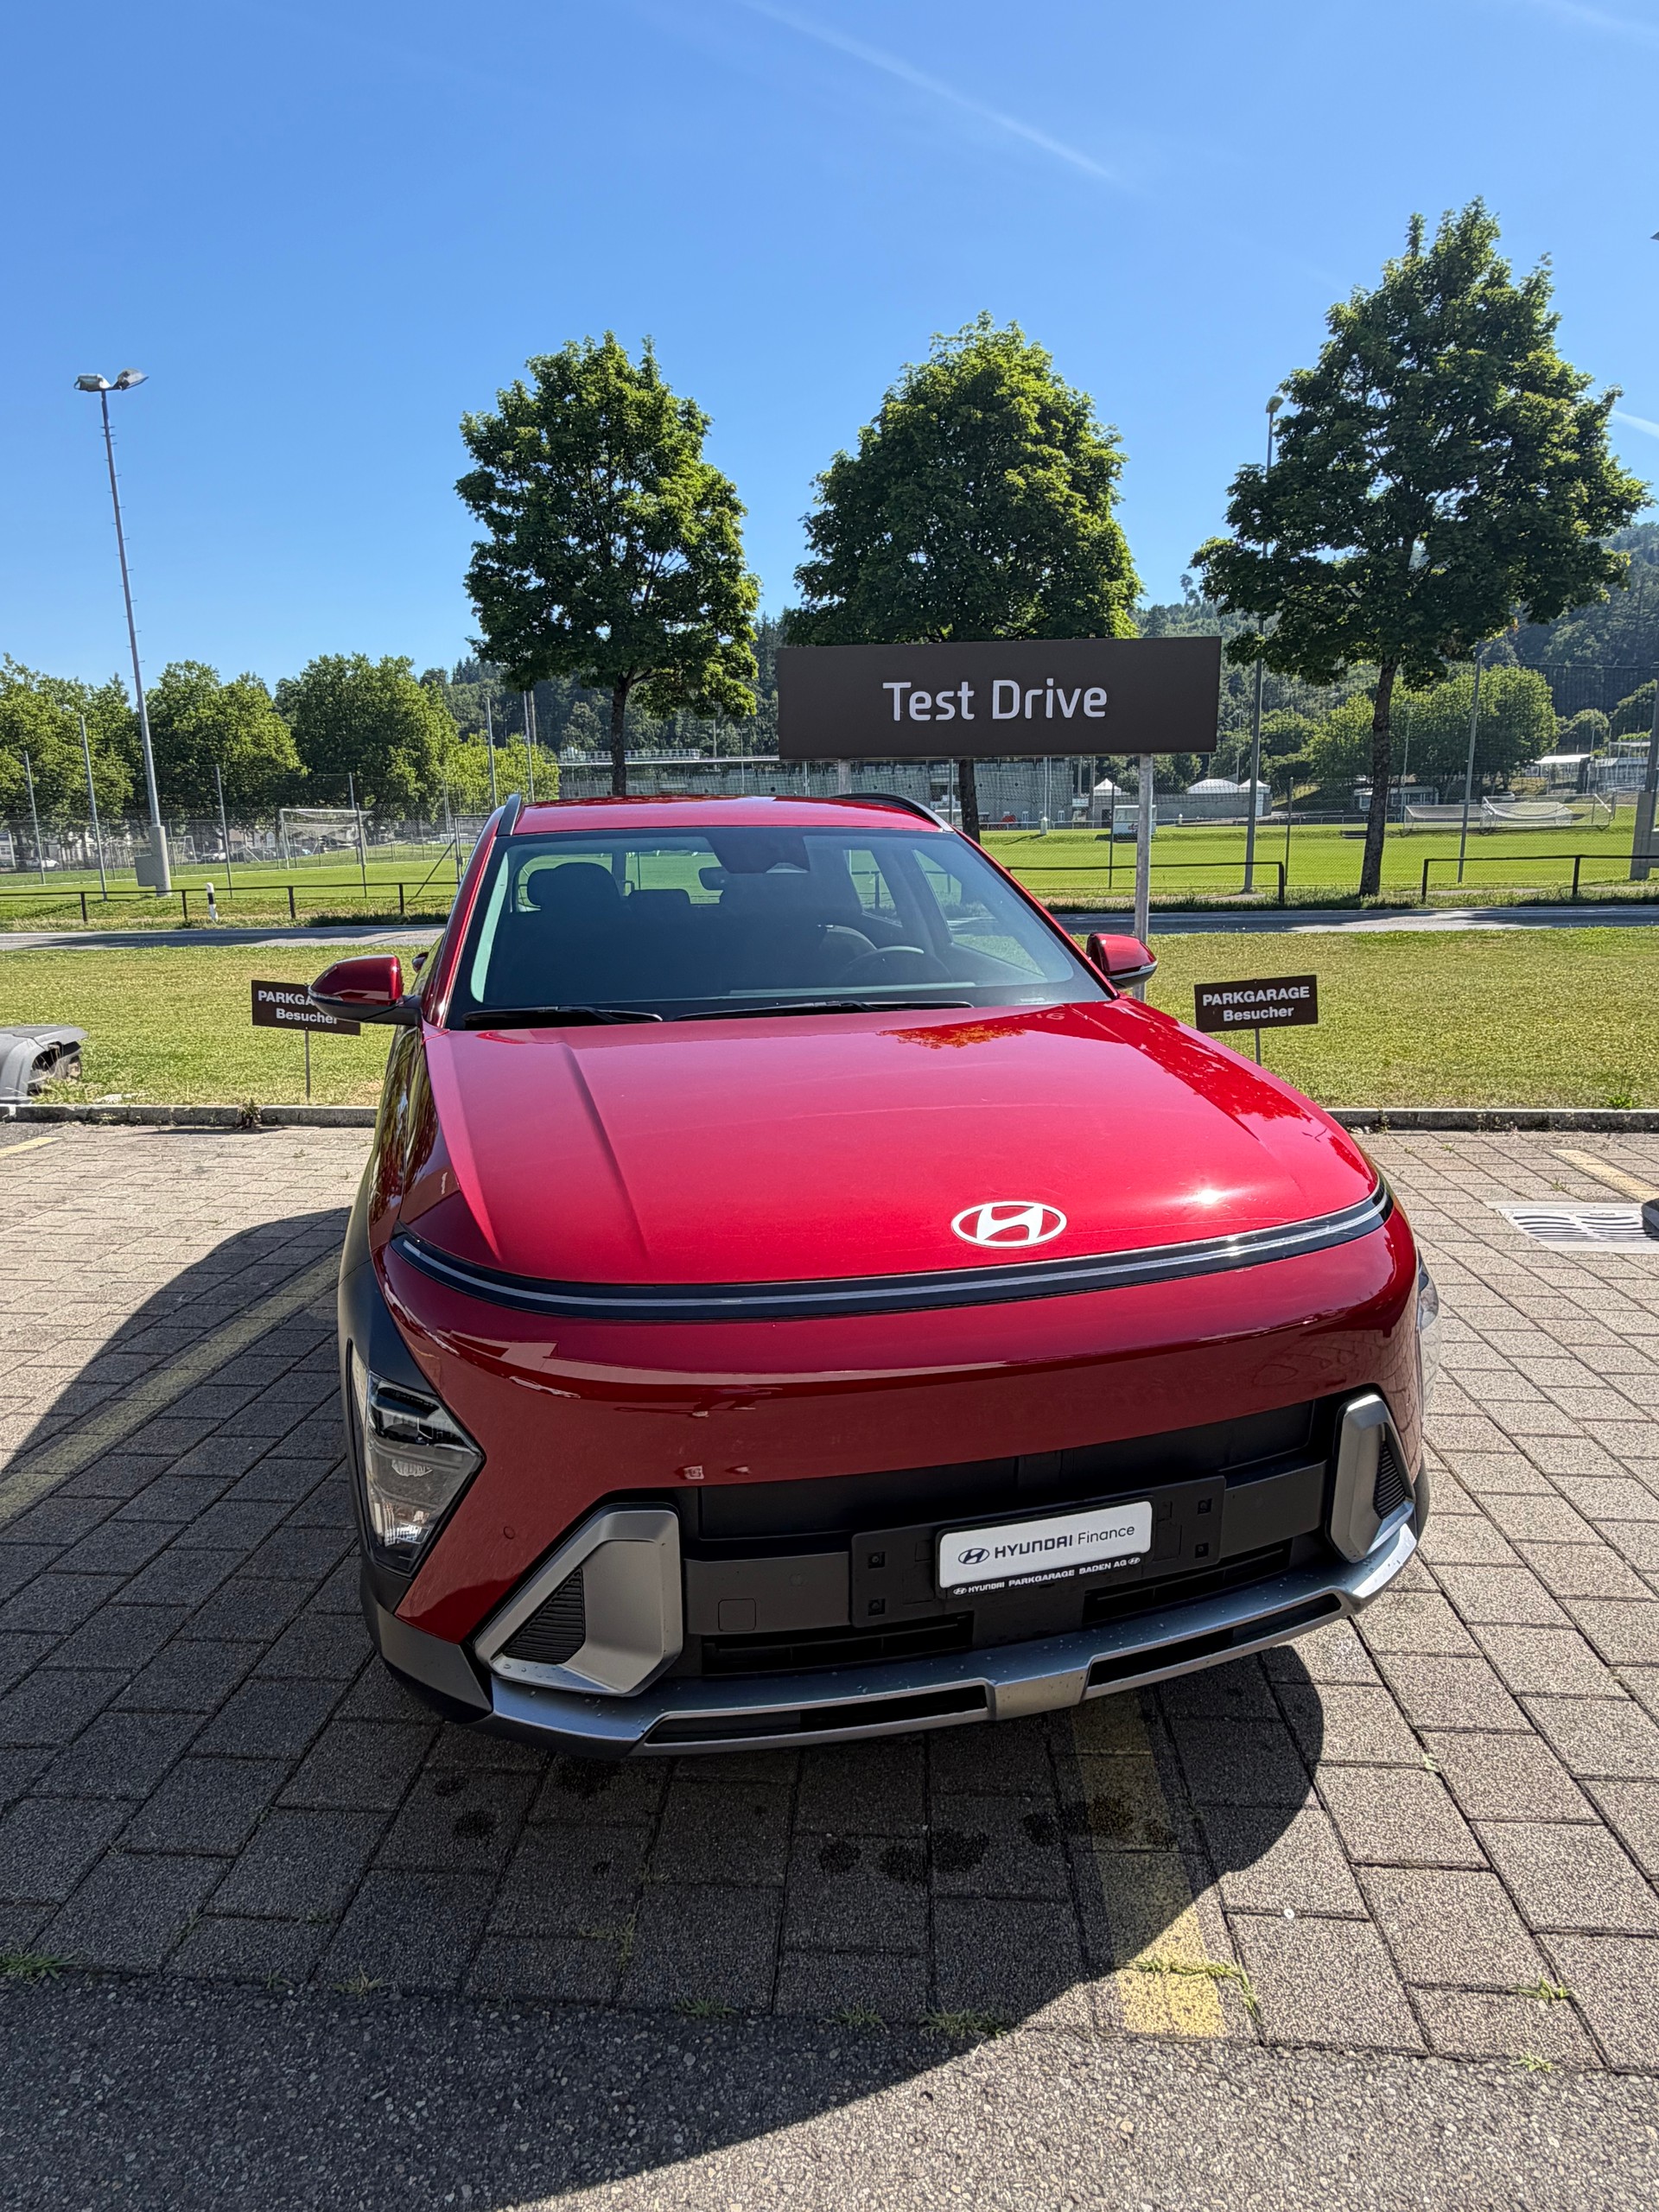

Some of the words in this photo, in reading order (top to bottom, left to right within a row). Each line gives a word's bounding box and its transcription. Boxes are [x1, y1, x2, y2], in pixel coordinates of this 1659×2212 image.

[882, 681, 975, 721] Test
[991, 677, 1108, 721] Drive
[1203, 986, 1310, 1007] PARKGARAGE
[1223, 1006, 1294, 1022] Besucher
[994, 1535, 1072, 1559] HYUNDAI
[1077, 1525, 1135, 1545] Finance
[968, 1581, 1005, 1593] HYUNDAI
[1008, 1569, 1075, 1586] PARKGARAGE
[1078, 1562, 1112, 1574] BADEN
[1113, 1559, 1128, 1568] AG
